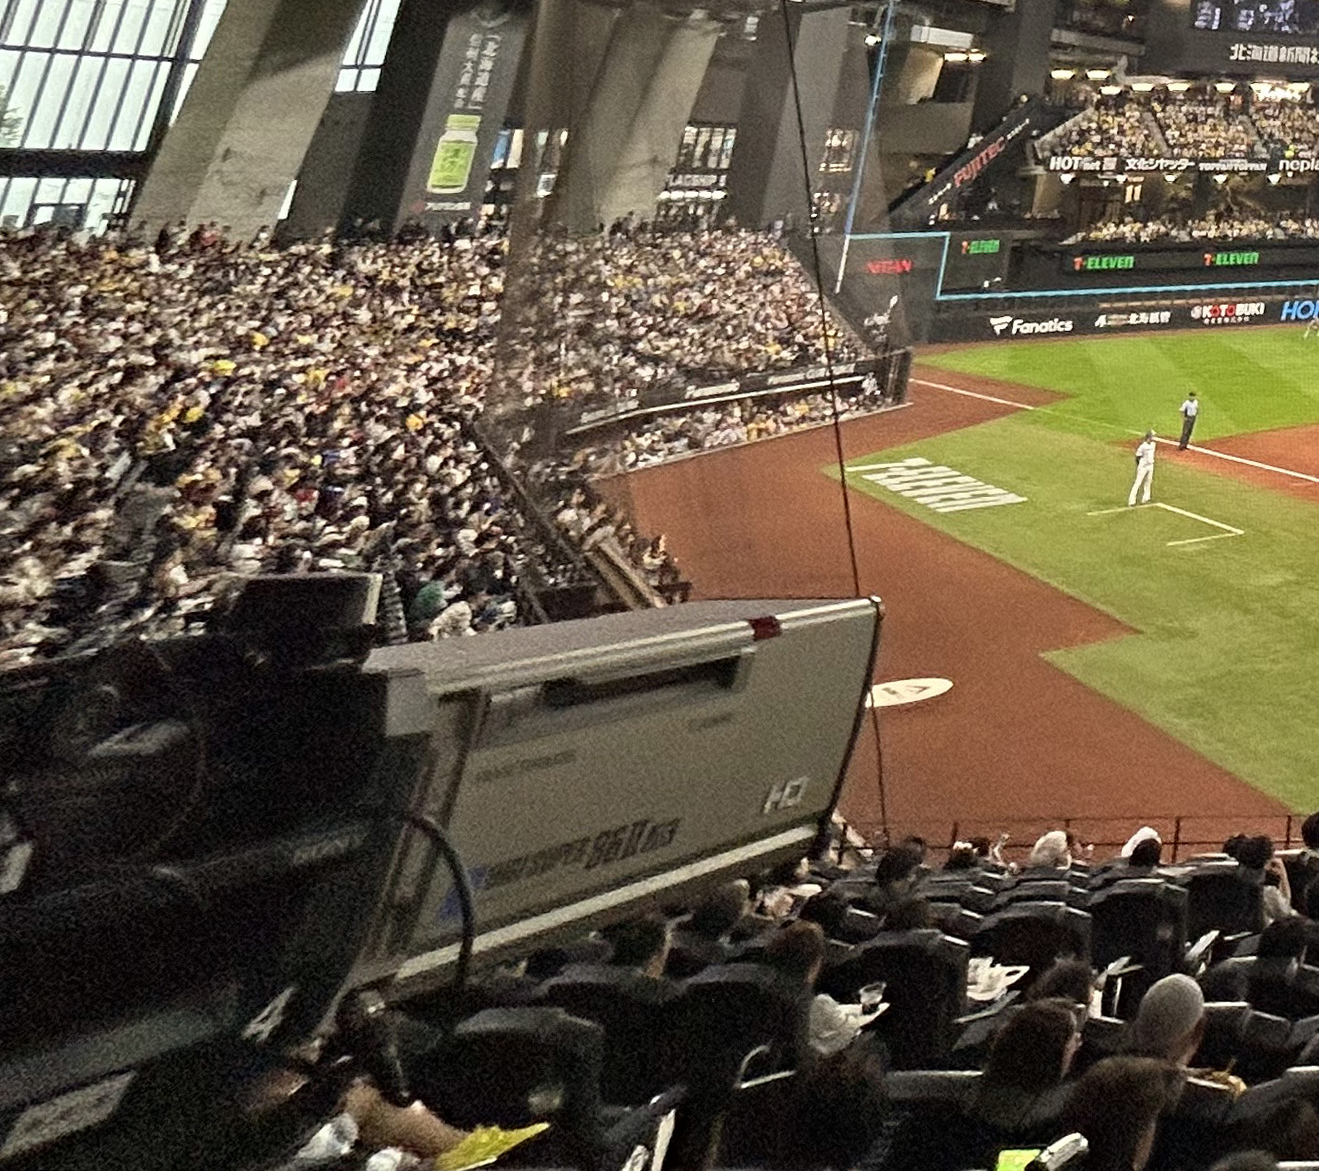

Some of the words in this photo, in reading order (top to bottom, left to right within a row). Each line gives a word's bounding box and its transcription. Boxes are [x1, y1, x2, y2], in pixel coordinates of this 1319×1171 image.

[1202, 302, 1266, 317] KOTOBUKI
[1011, 318, 1074, 336] Fanatics
[762, 774, 808, 814] HD
